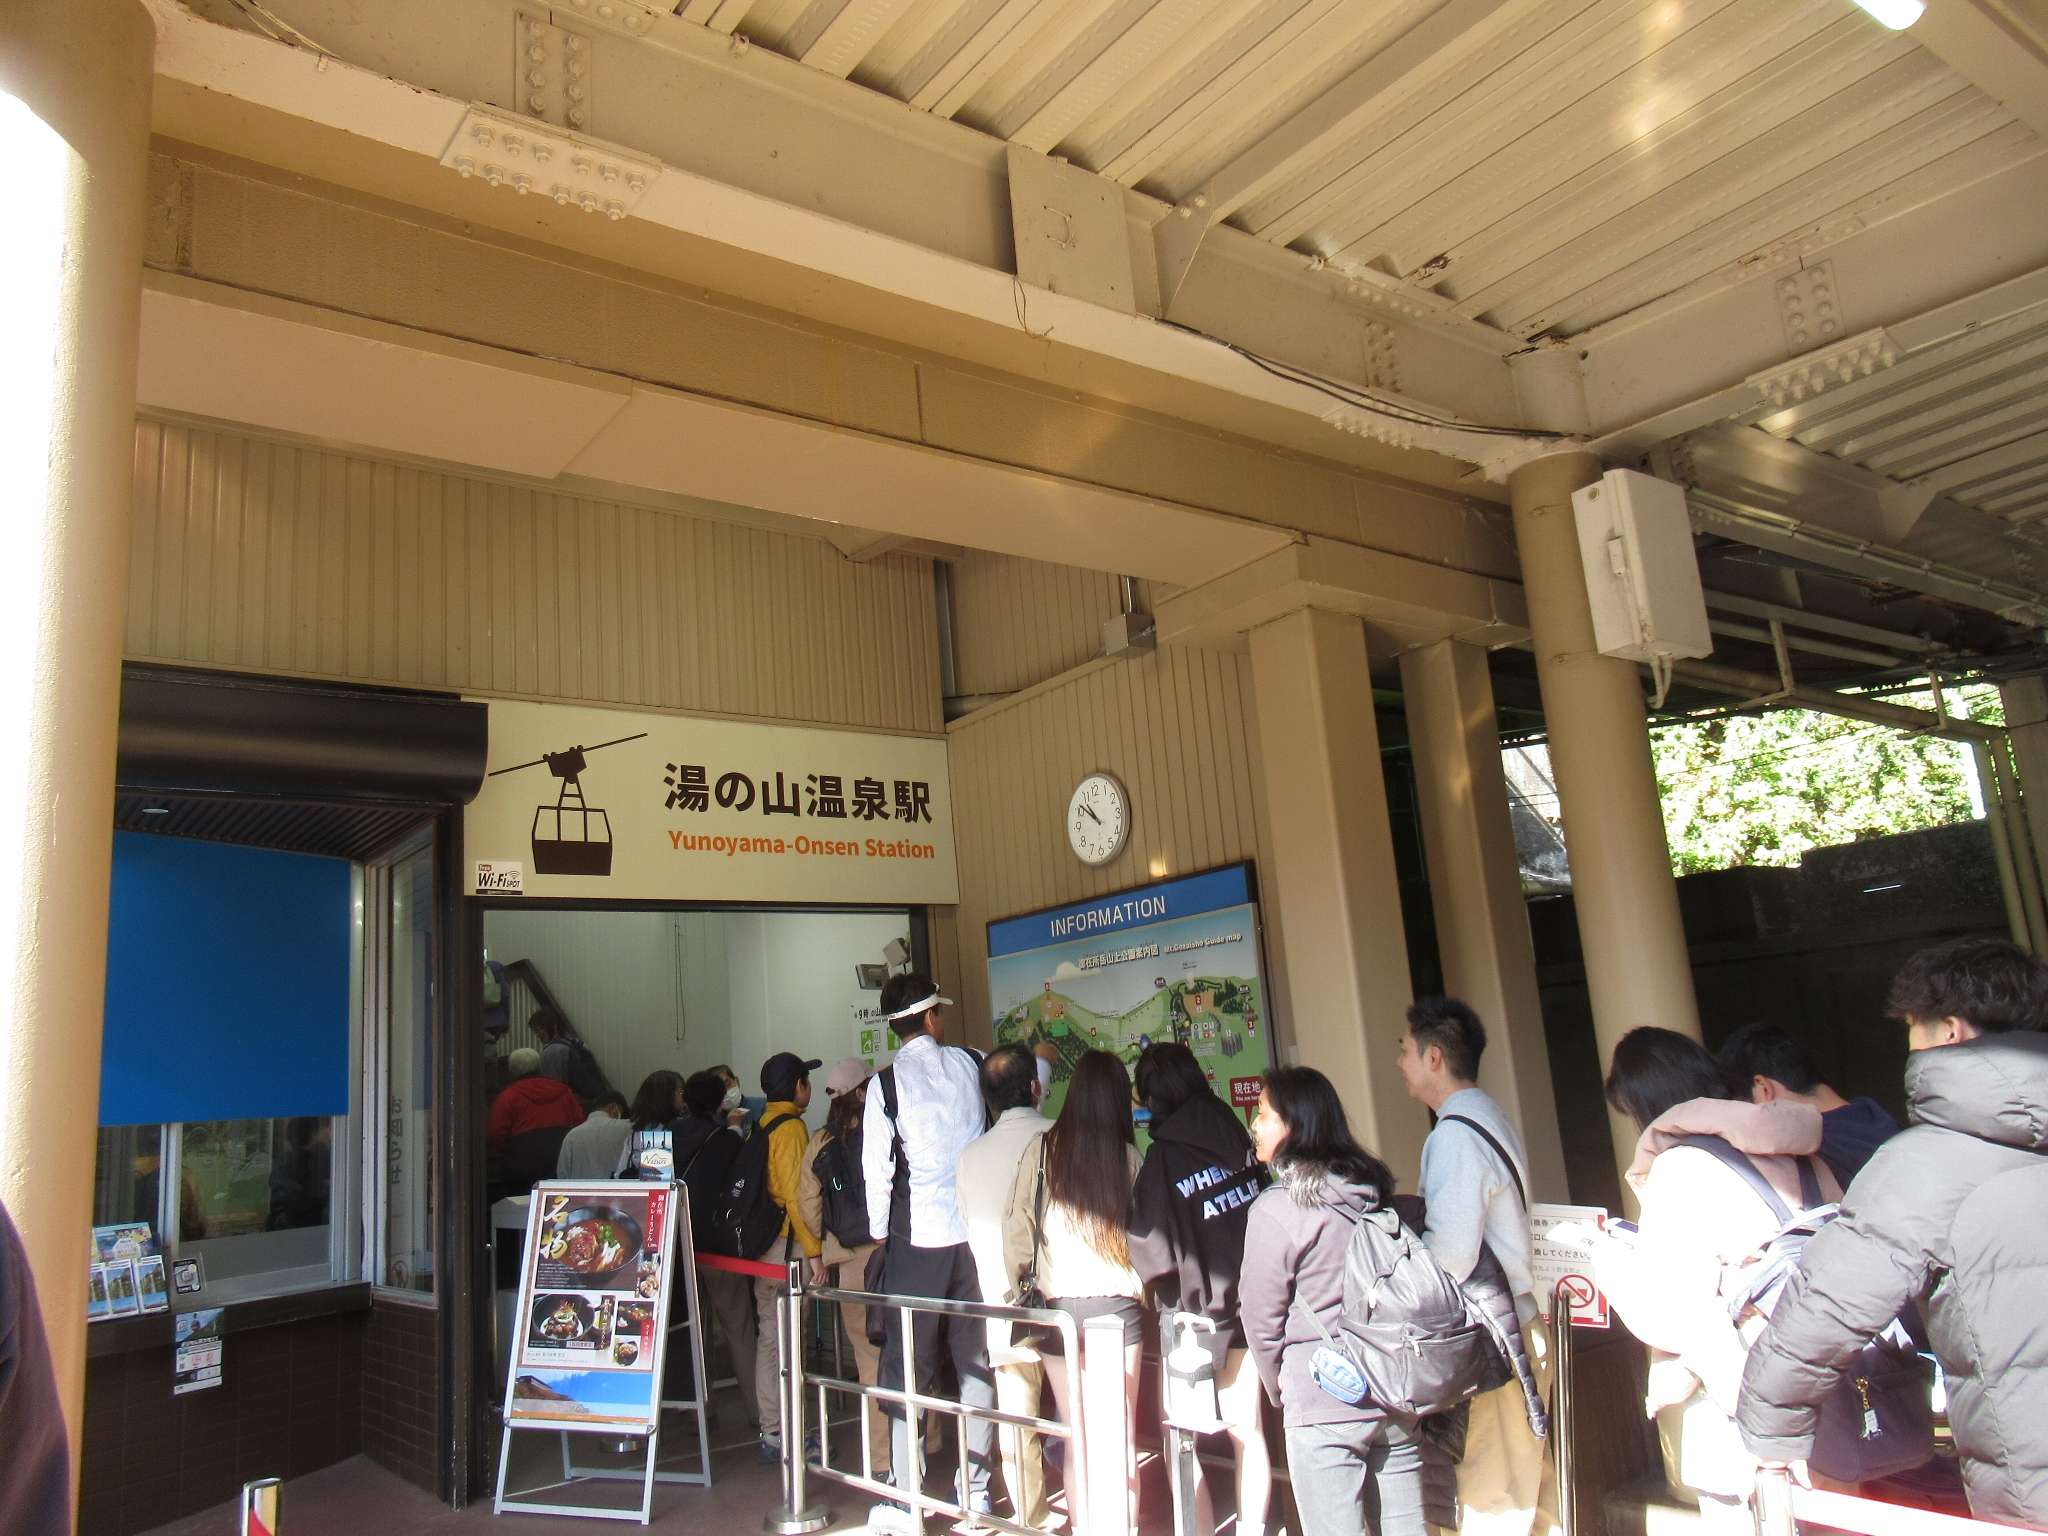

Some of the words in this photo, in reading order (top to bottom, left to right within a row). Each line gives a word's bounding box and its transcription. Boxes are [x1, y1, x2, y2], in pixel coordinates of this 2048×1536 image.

[663, 762, 932, 824] 湯の山温泉駅
[1091, 784, 1098, 796] 12
[1082, 791, 1090, 803] 11
[1110, 793, 1116, 804] 2
[1115, 807, 1121, 819] 3
[1075, 821, 1082, 832] 9
[1114, 824, 1120, 835] 4
[668, 830, 860, 856] Yunoyama-Onsen
[865, 838, 935, 859] Station
[1080, 835, 1087, 848] 8
[1107, 837, 1114, 849] 5
[1089, 843, 1095, 856] 7
[1098, 844, 1105, 856] 6
[479, 872, 508, 887] Wi-Fi
[1050, 896, 1166, 937] INFORMATION
